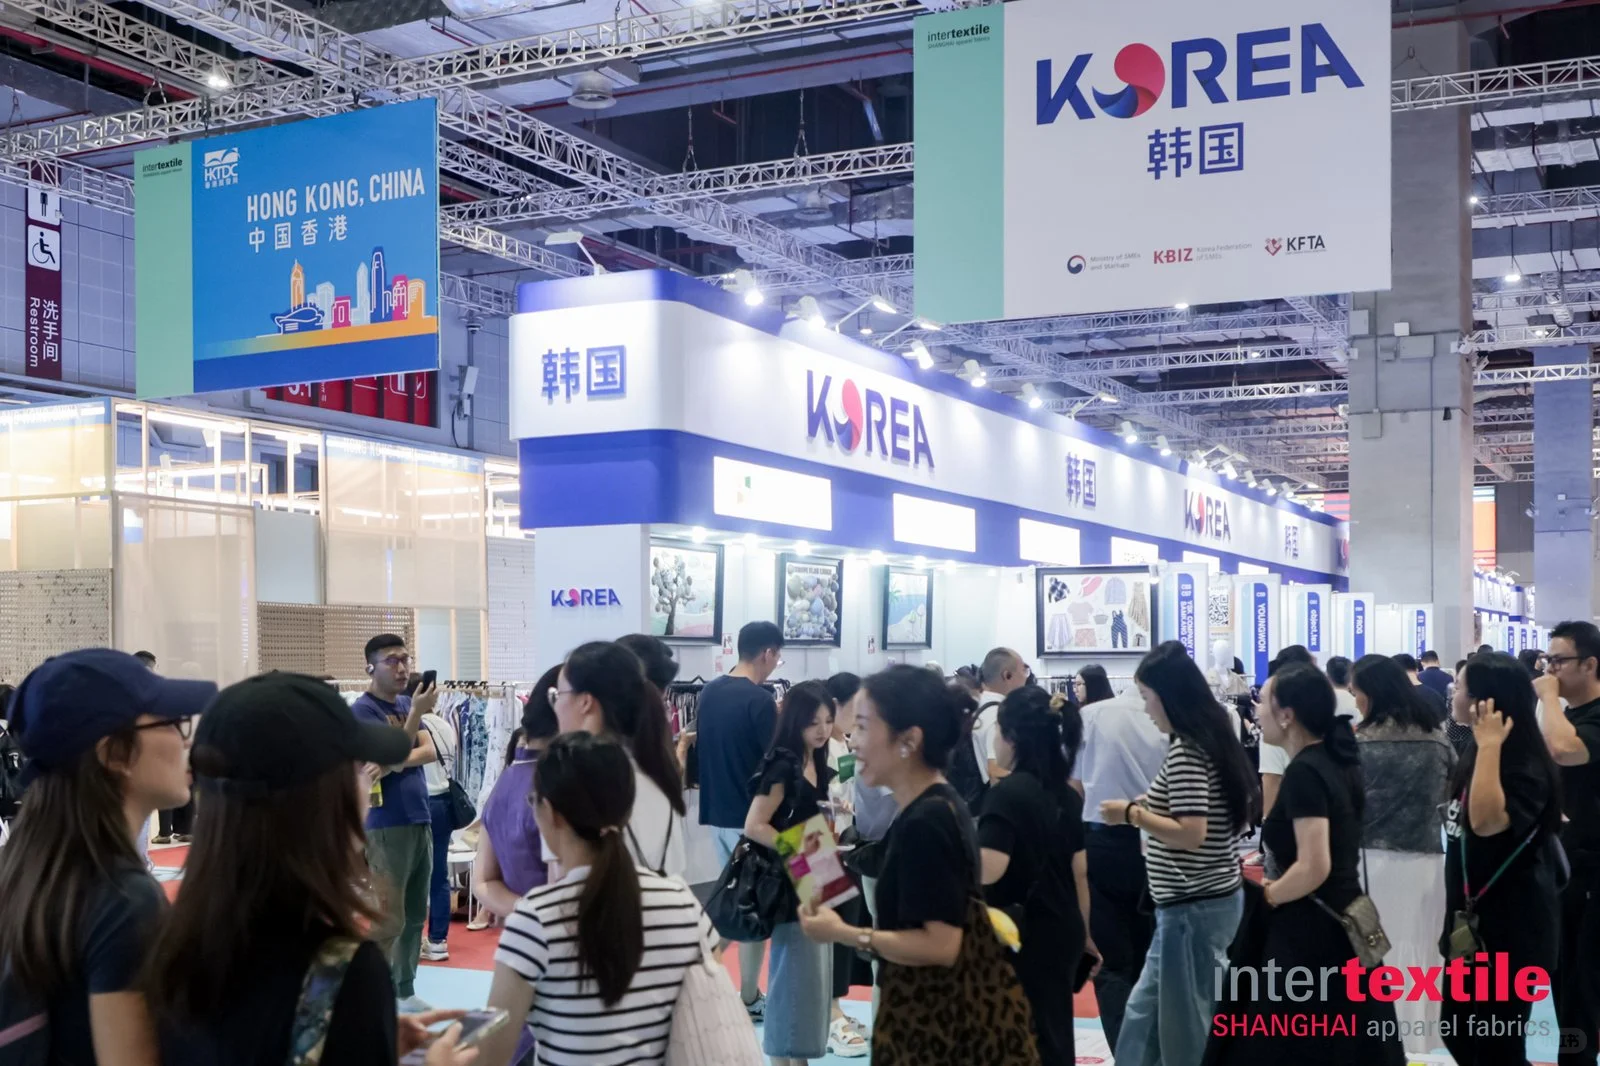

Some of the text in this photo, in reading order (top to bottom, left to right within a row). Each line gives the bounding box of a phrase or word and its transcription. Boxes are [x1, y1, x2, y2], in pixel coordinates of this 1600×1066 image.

[927, 23, 990, 42] intertextile
[1036, 22, 1365, 126] KOREA
[142, 157, 183, 172] intertextile
[204, 163, 238, 181] HKTDC
[1146, 122, 1244, 180] 韩国
[247, 167, 426, 222] HONG KONG, CHINA
[249, 214, 347, 253] 中国香港
[1287, 235, 1325, 251] KFTA
[30, 296, 40, 368] Restroom
[42, 299, 59, 362] 洗手间
[541, 345, 626, 402] 韩国
[806, 369, 935, 469] KOREA
[1066, 452, 1096, 507] 韩国
[1184, 489, 1231, 541] KOREA
[551, 588, 621, 607] KOREA
[1186, 615, 1194, 649] COMPANY
[1257, 603, 1267, 652] YOUNGWON
[1355, 615, 1363, 634] FROG
